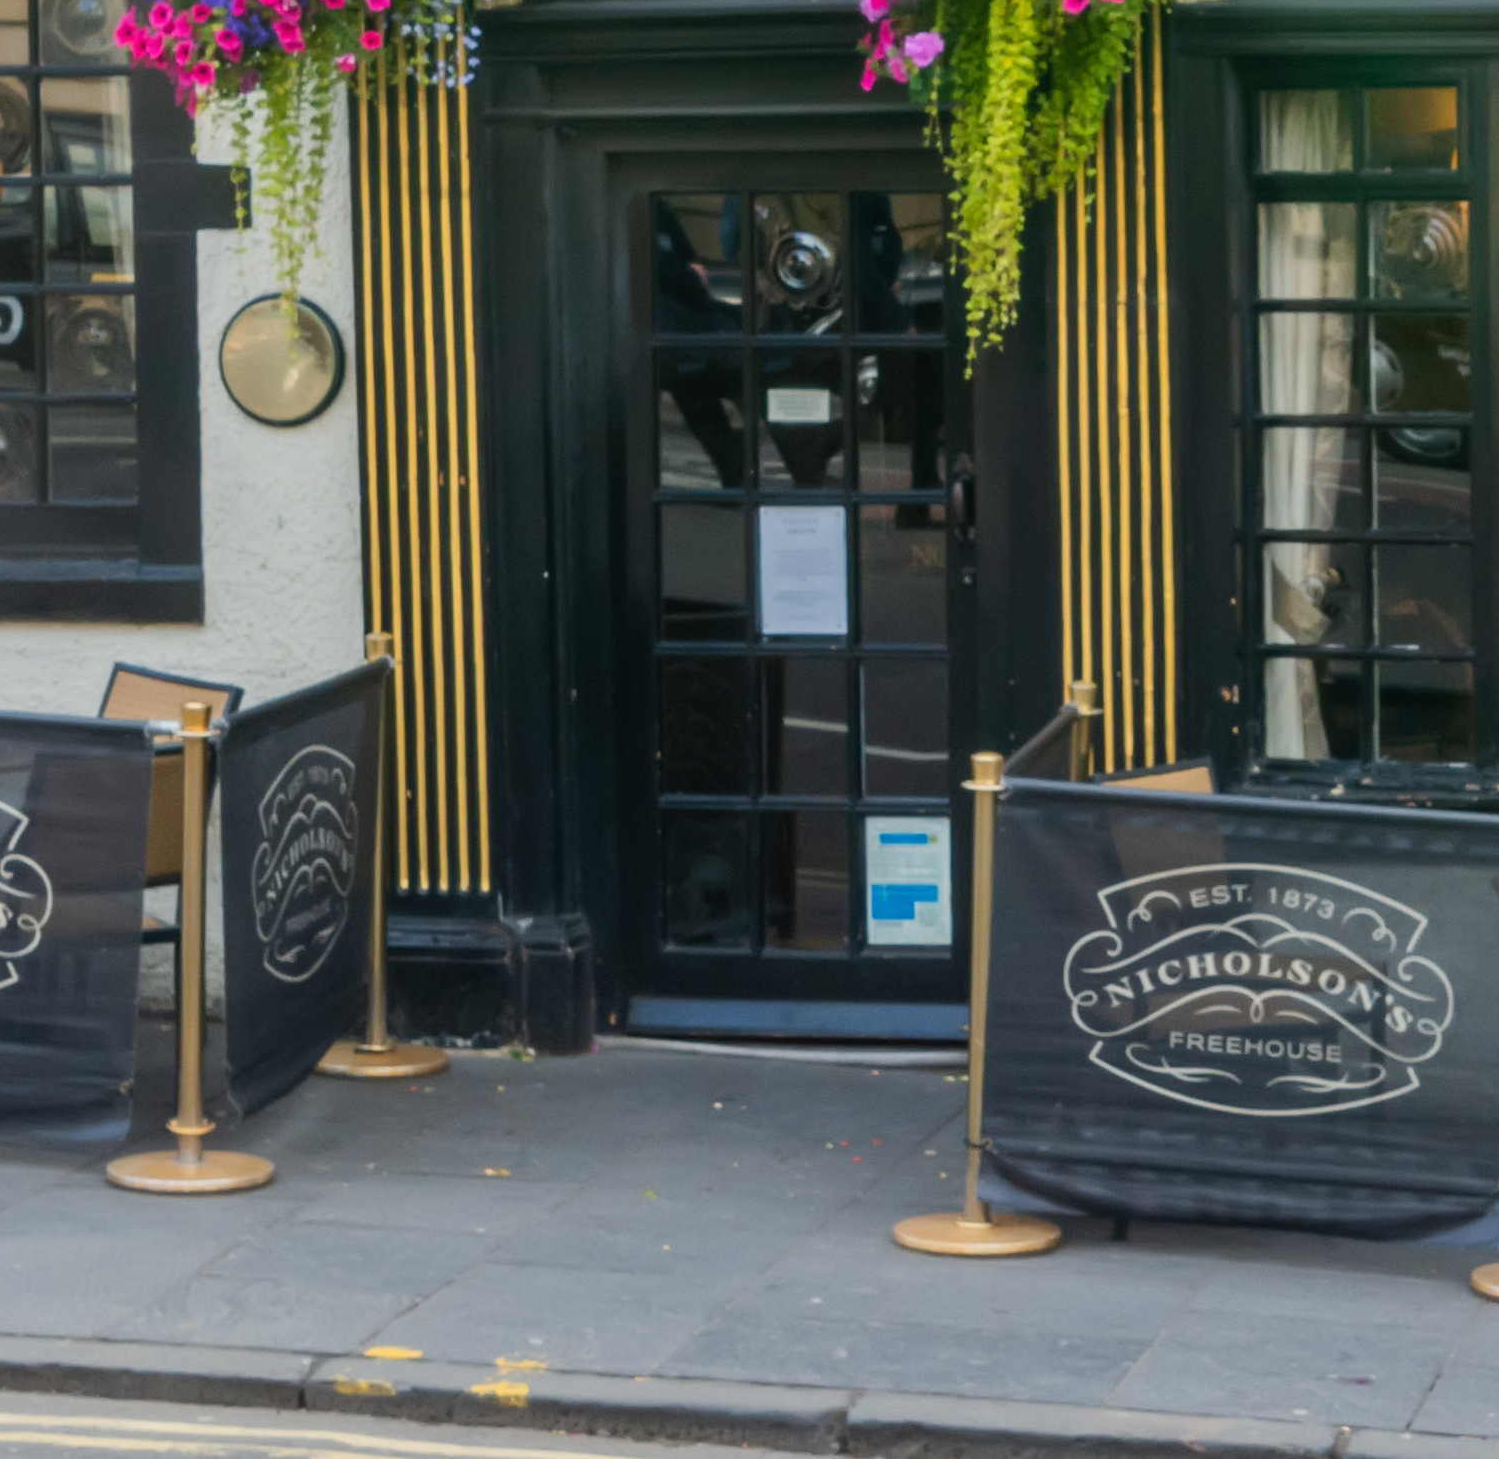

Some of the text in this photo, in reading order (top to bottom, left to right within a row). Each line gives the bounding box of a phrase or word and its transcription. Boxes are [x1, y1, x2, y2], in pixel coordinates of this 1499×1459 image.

[1267, 887, 1336, 920] 1873
[1102, 951, 1414, 1034] NICHOLSON'S
[1168, 1030, 1342, 1063] FREEHOUSE
